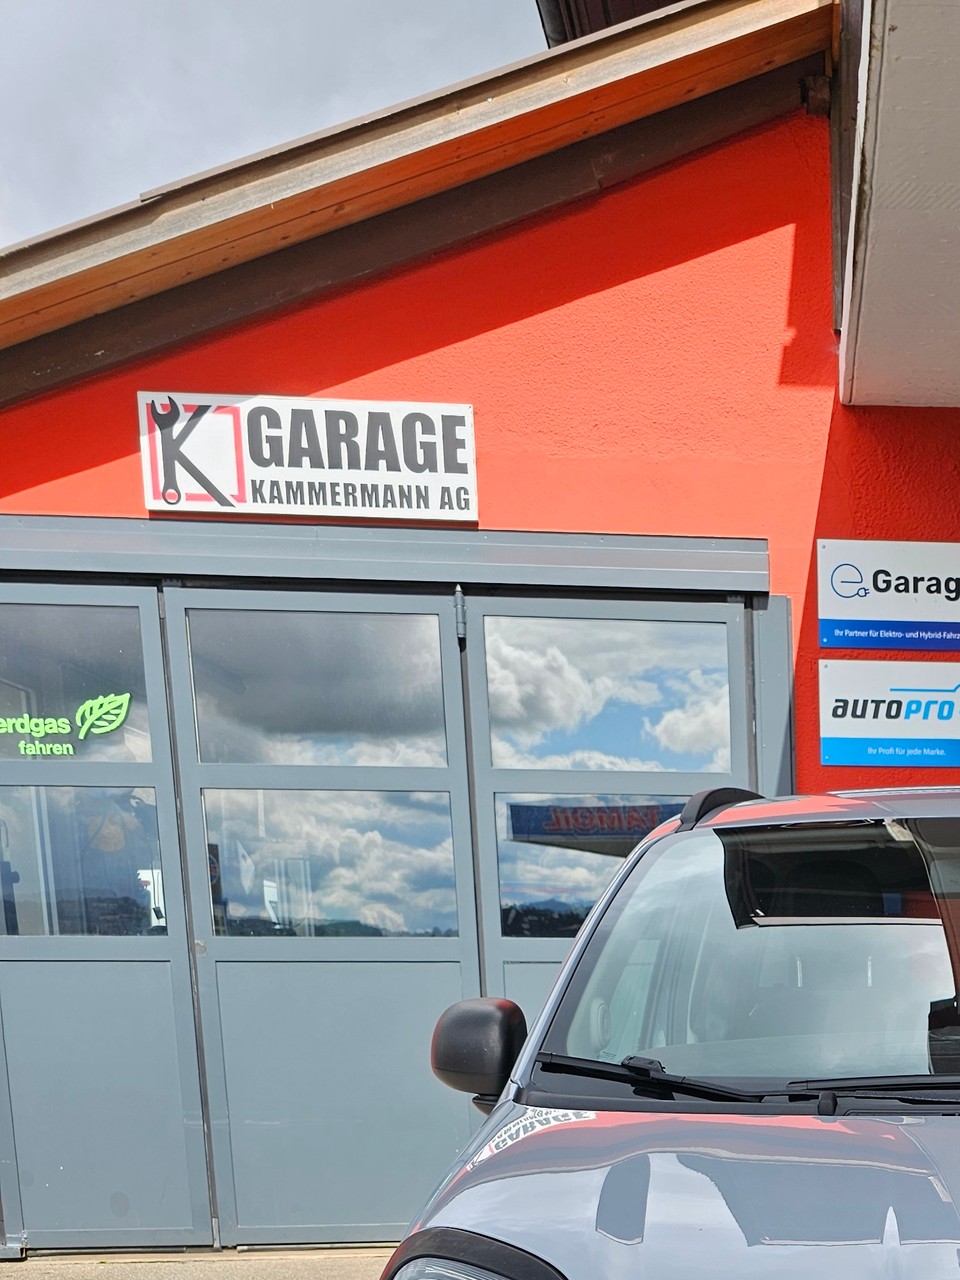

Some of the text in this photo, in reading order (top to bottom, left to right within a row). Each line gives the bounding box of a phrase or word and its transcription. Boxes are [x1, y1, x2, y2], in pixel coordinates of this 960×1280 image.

[246, 406, 469, 474] GARAGE
[251, 479, 471, 511] KAMMERMANN AG
[834, 629, 844, 637] Ihr
[845, 629, 868, 638] Partner
[869, 629, 879, 638] für
[880, 630, 905, 639] Elektro-
[905, 631, 919, 639] und
[18, 740, 74, 755] fahren
[867, 746, 946, 757] Ihr Profi für jede Marke.
